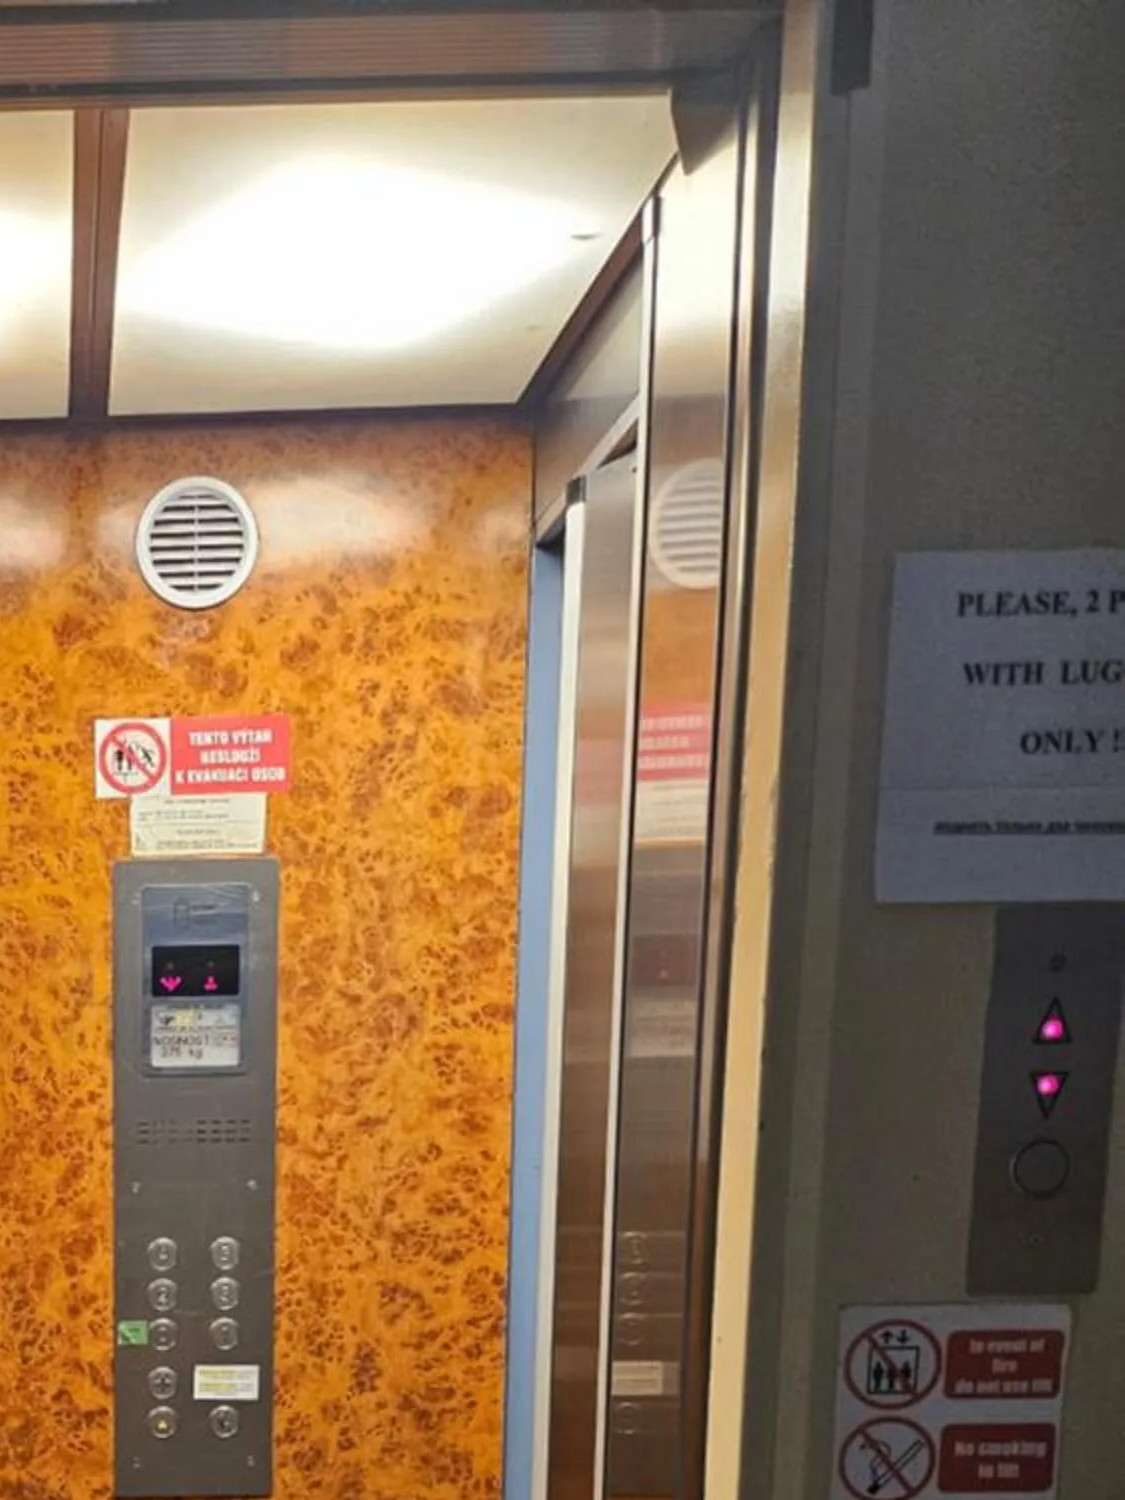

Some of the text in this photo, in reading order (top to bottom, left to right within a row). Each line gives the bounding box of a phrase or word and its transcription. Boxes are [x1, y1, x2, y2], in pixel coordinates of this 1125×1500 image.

[958, 591, 1078, 618] PLEASE,
[1085, 589, 1100, 614] 2
[962, 661, 1045, 687] WITH
[1019, 729, 1106, 755] ONLY
